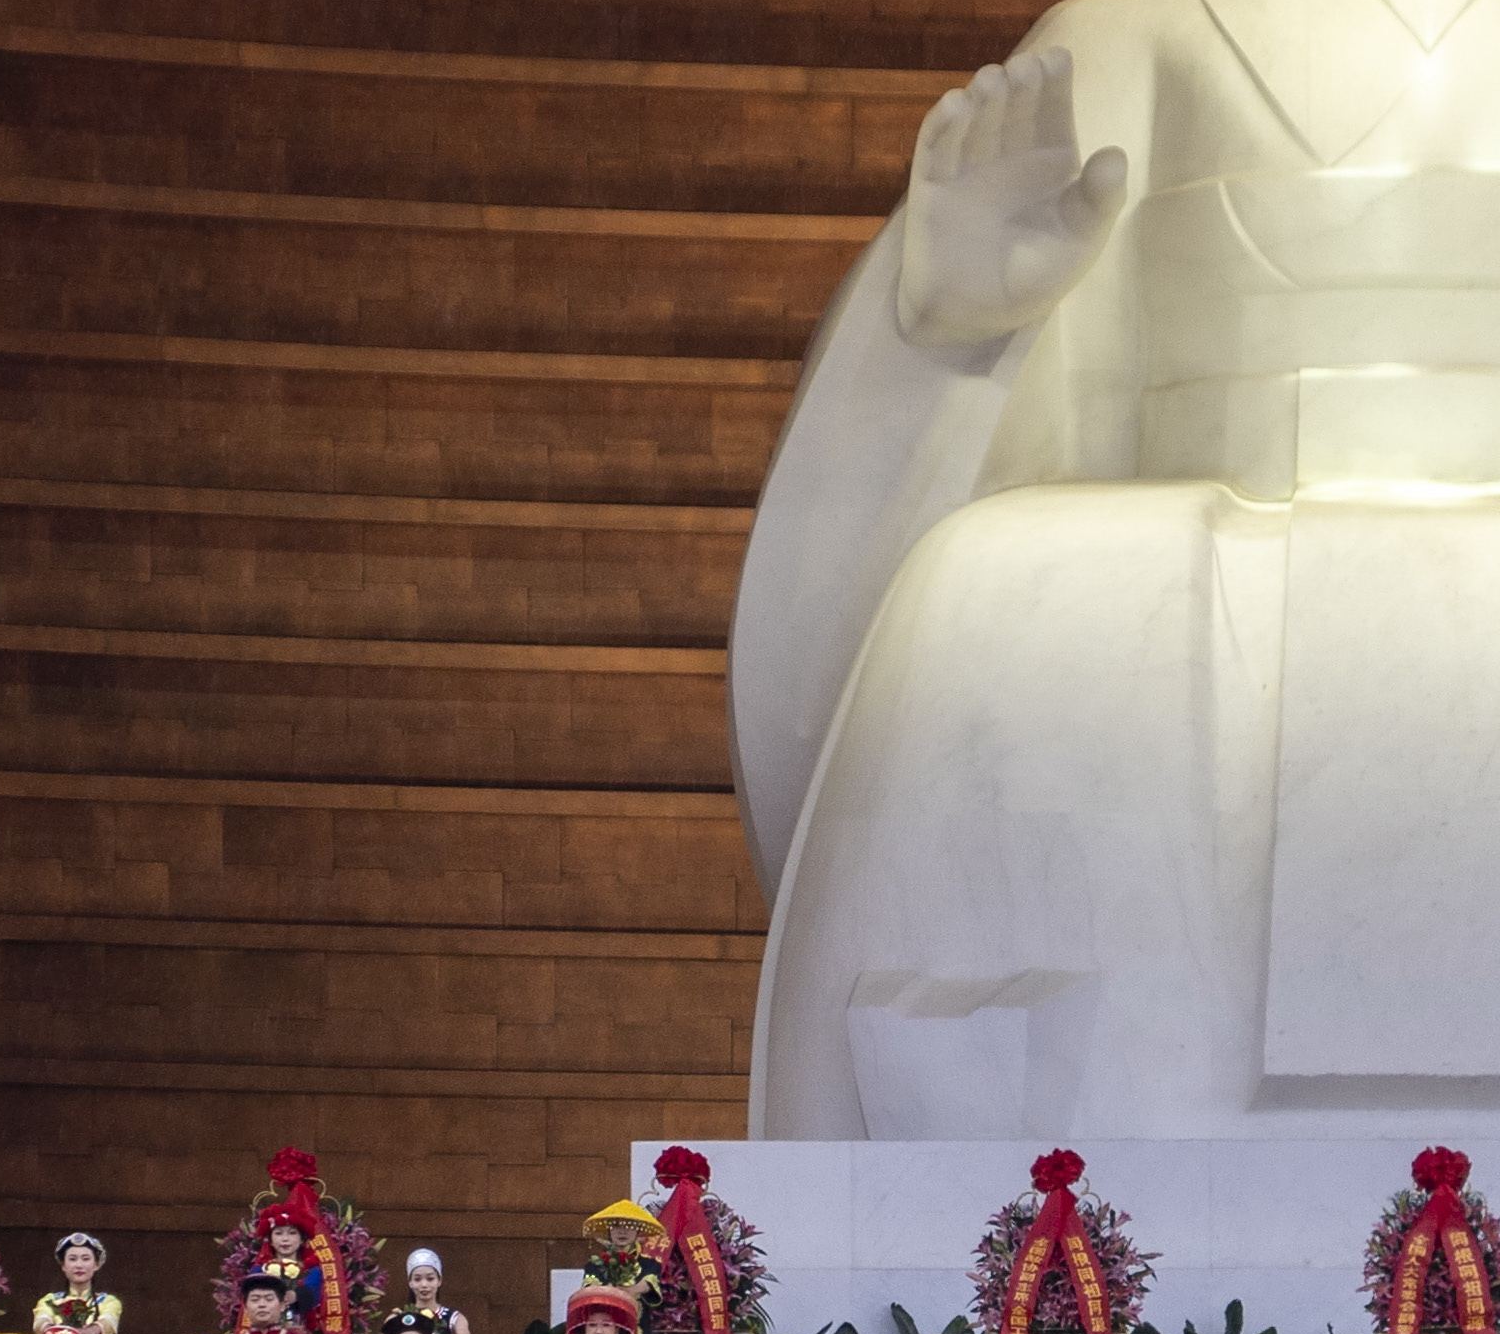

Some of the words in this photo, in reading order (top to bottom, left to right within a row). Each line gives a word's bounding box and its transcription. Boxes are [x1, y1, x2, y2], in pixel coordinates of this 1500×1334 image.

[687, 1233, 725, 1330] 同根同祖同源
[1066, 1236, 1106, 1333] 同根同祖同源
[1449, 1231, 1486, 1331] 同根同祖同源
